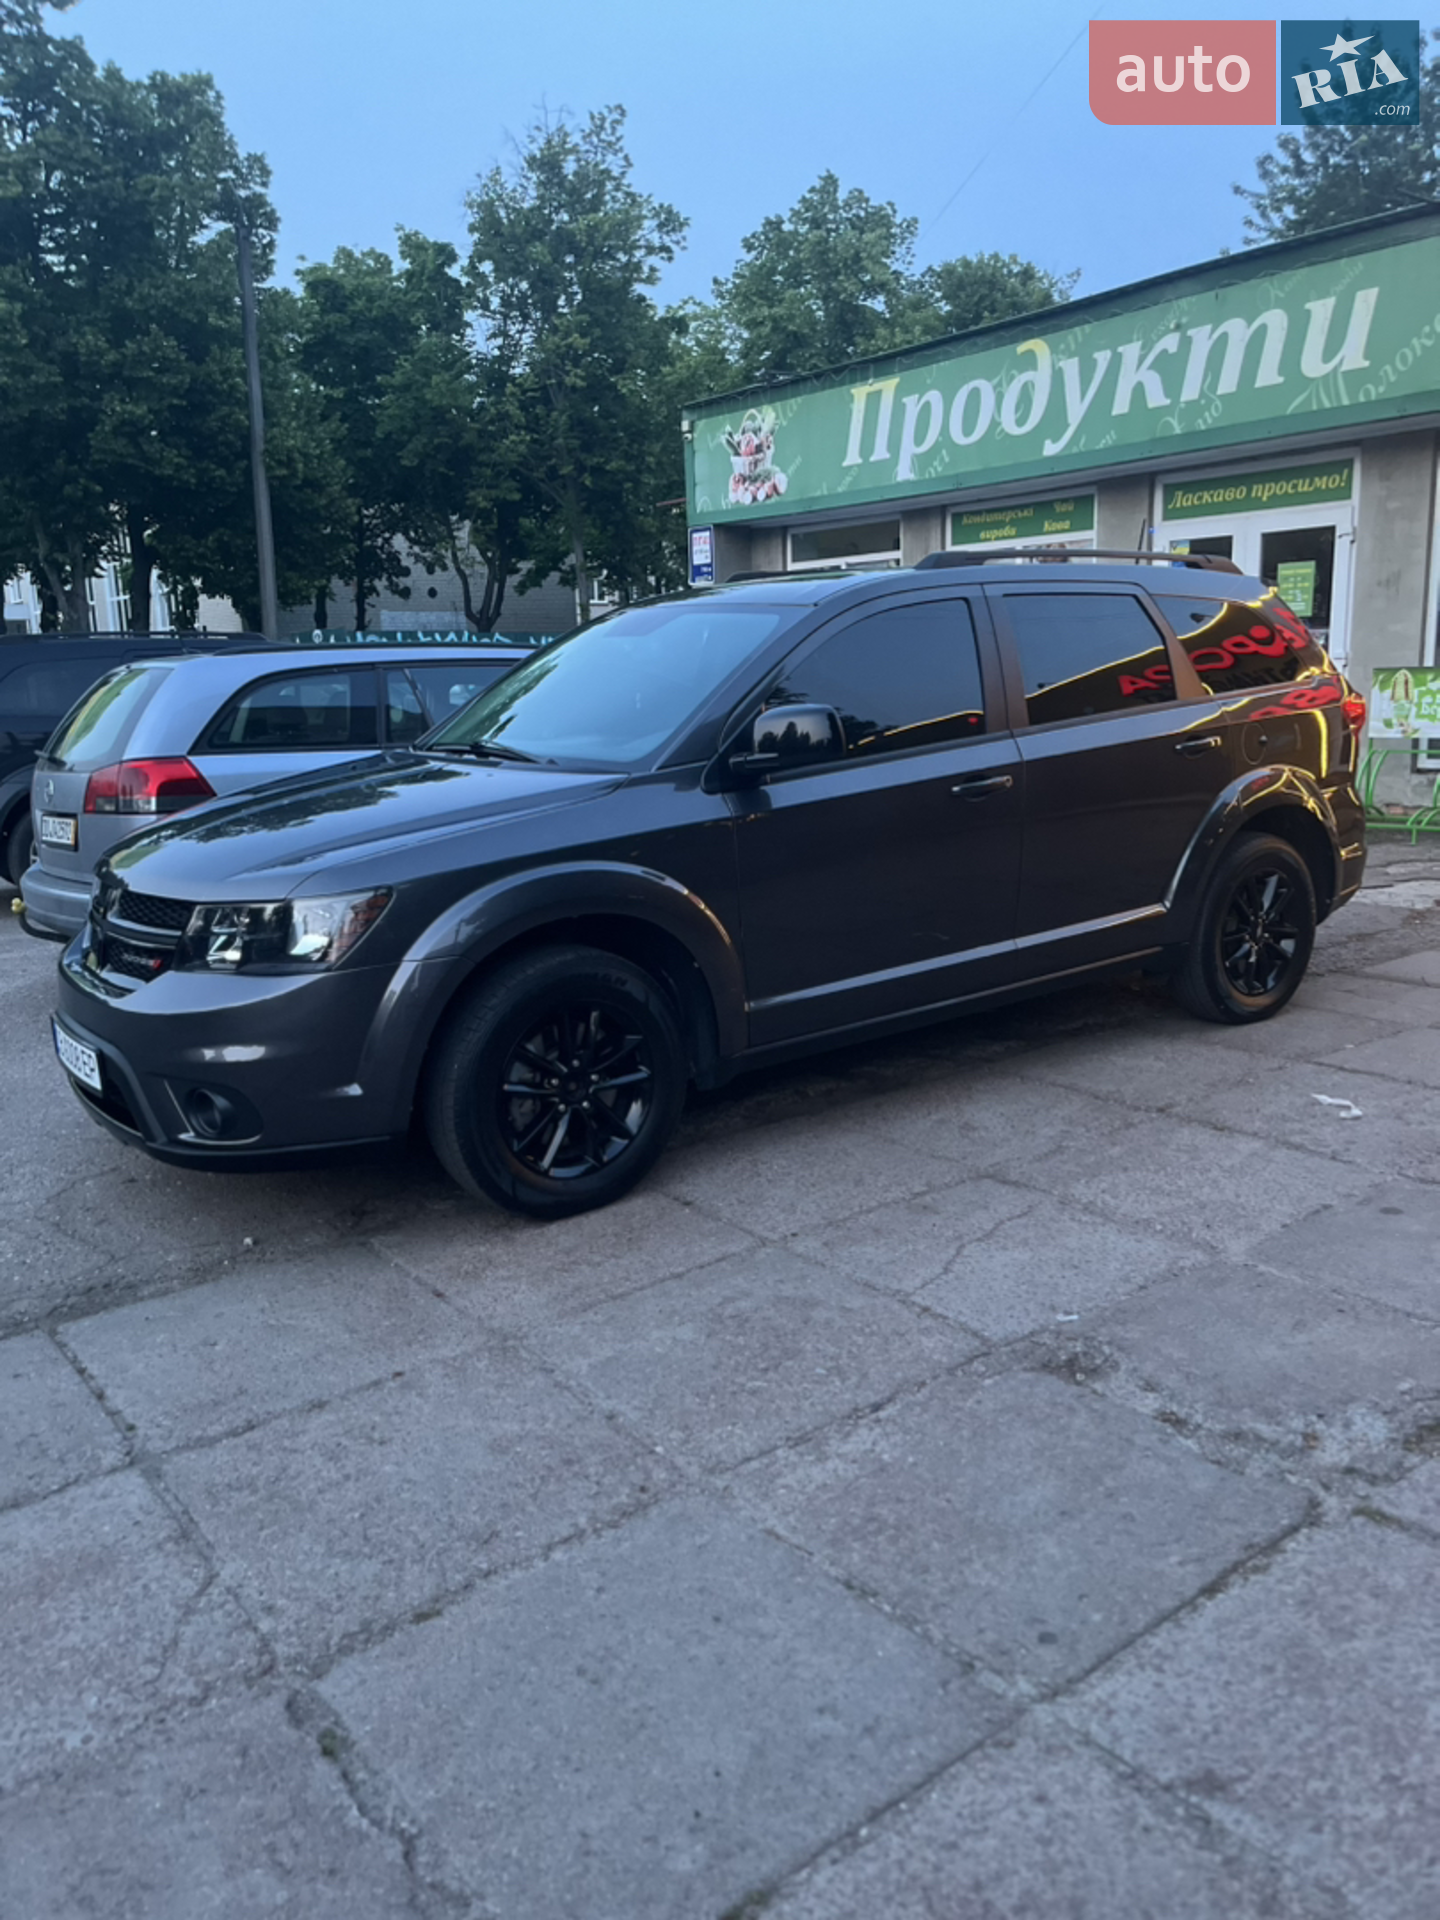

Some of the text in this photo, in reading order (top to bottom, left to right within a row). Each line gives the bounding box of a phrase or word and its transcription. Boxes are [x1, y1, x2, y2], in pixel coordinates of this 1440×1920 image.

[841, 286, 1380, 482] Продукти
[1168, 468, 1349, 510] Ласкаво просимо!
